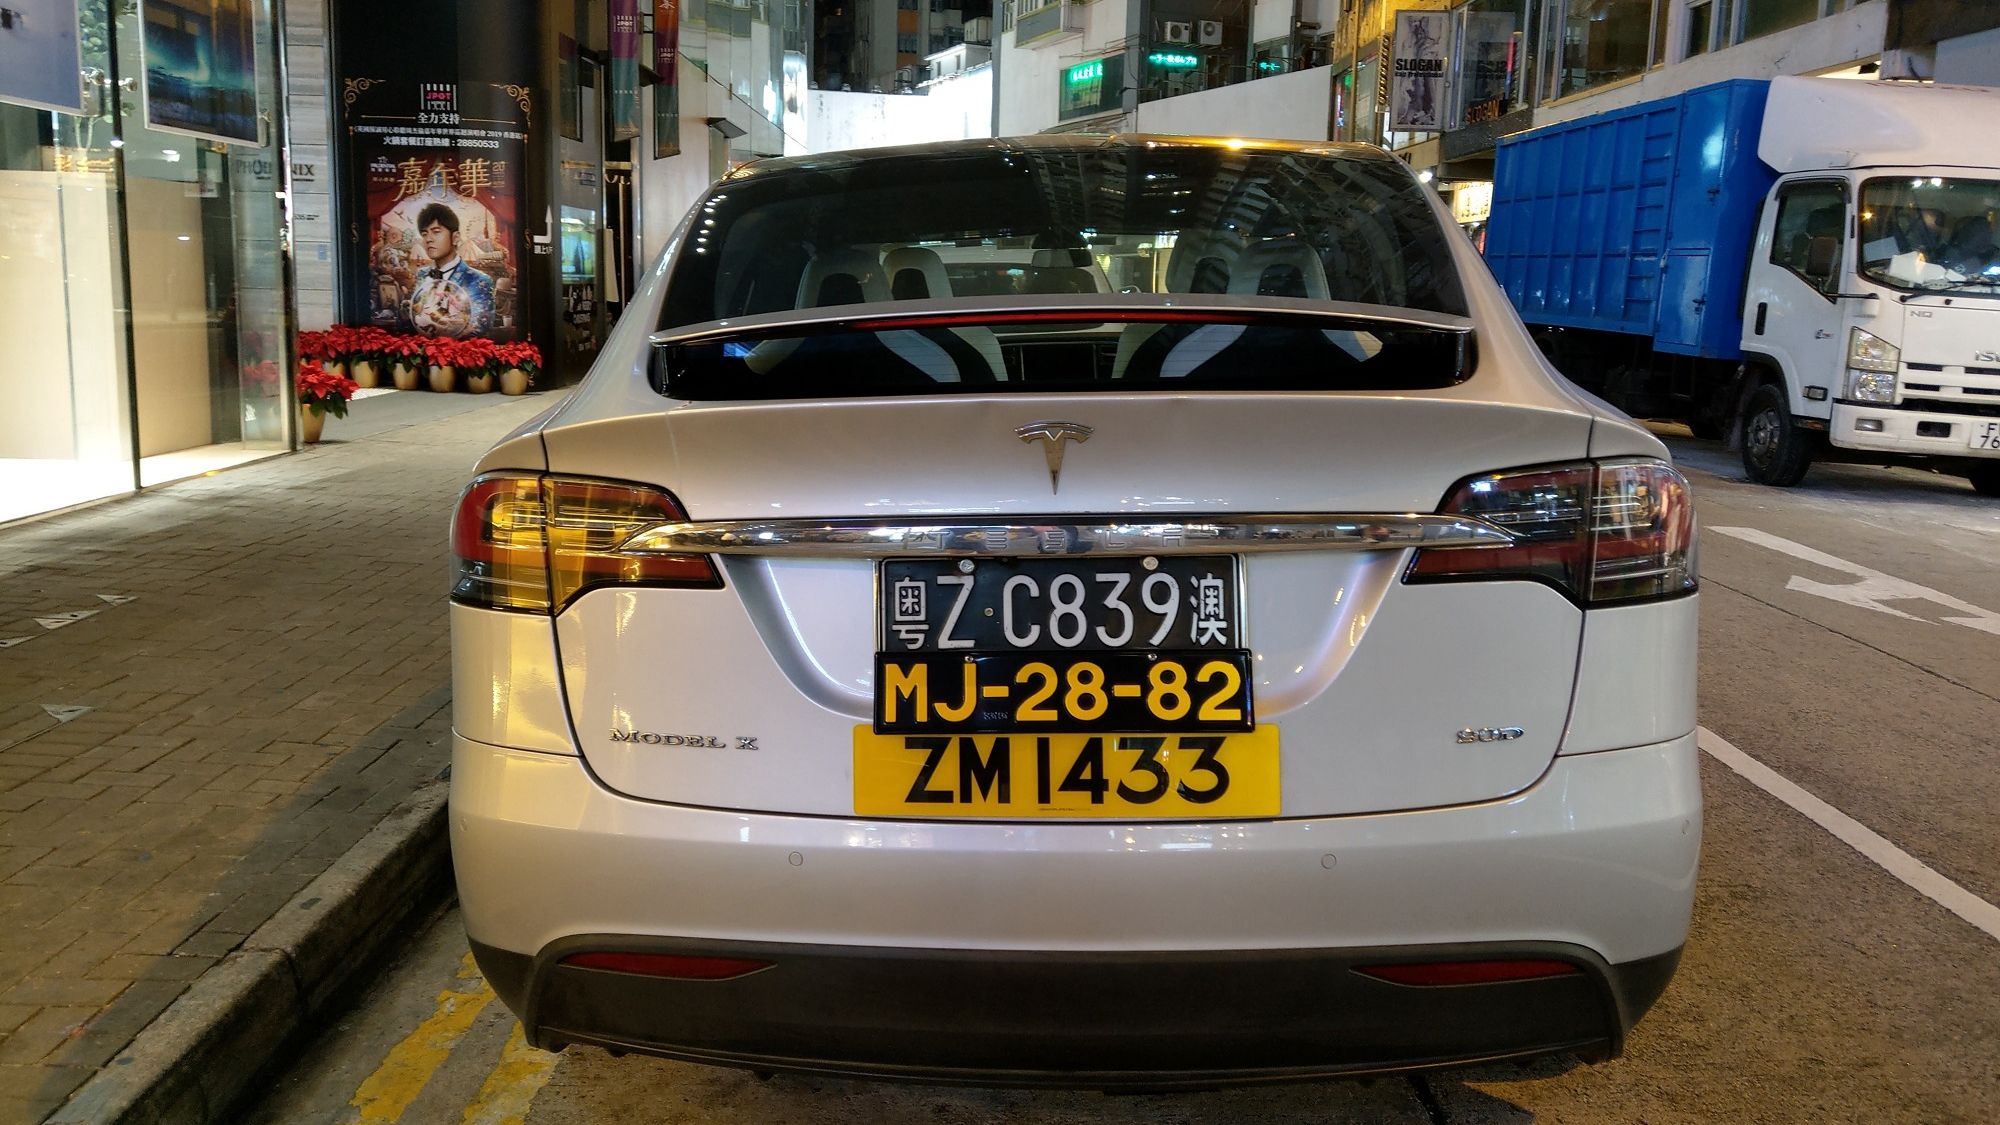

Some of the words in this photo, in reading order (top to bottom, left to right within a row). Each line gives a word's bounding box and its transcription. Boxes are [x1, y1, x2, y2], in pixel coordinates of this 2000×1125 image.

[1395, 58, 1443, 72] SLOGAN
[426, 92, 452, 100] JPOT
[417, 112, 460, 125] 全力支持
[392, 157, 491, 201] 嘉年華
[885, 661, 1242, 723] MJ-28-82
[609, 728, 726, 748] MODEL
[736, 736, 759, 750] X
